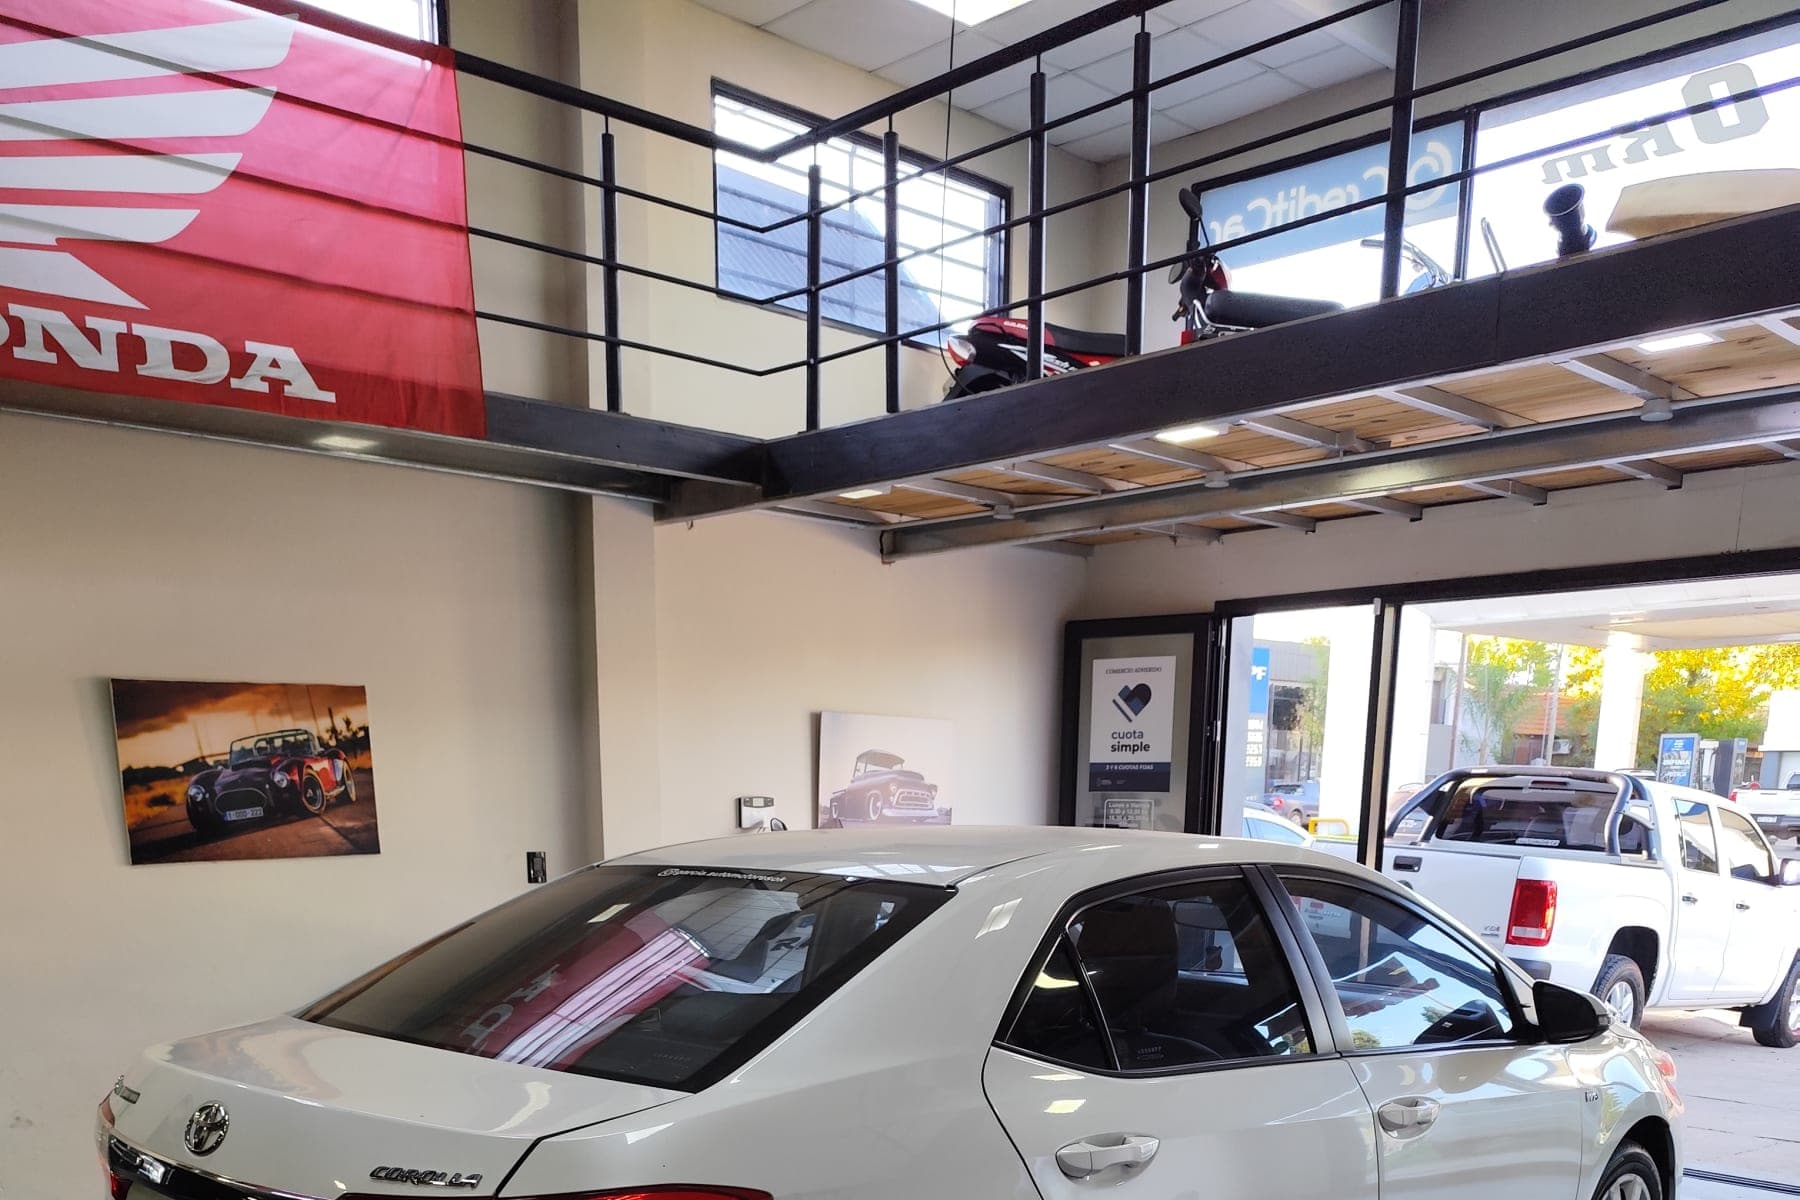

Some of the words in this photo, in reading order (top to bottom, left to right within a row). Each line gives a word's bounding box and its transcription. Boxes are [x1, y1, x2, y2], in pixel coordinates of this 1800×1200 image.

[0, 303, 337, 403] NDA
[1111, 730, 1144, 740] cuota
[1110, 741, 1151, 755] simple
[369, 1166, 483, 1189] COROLLA
